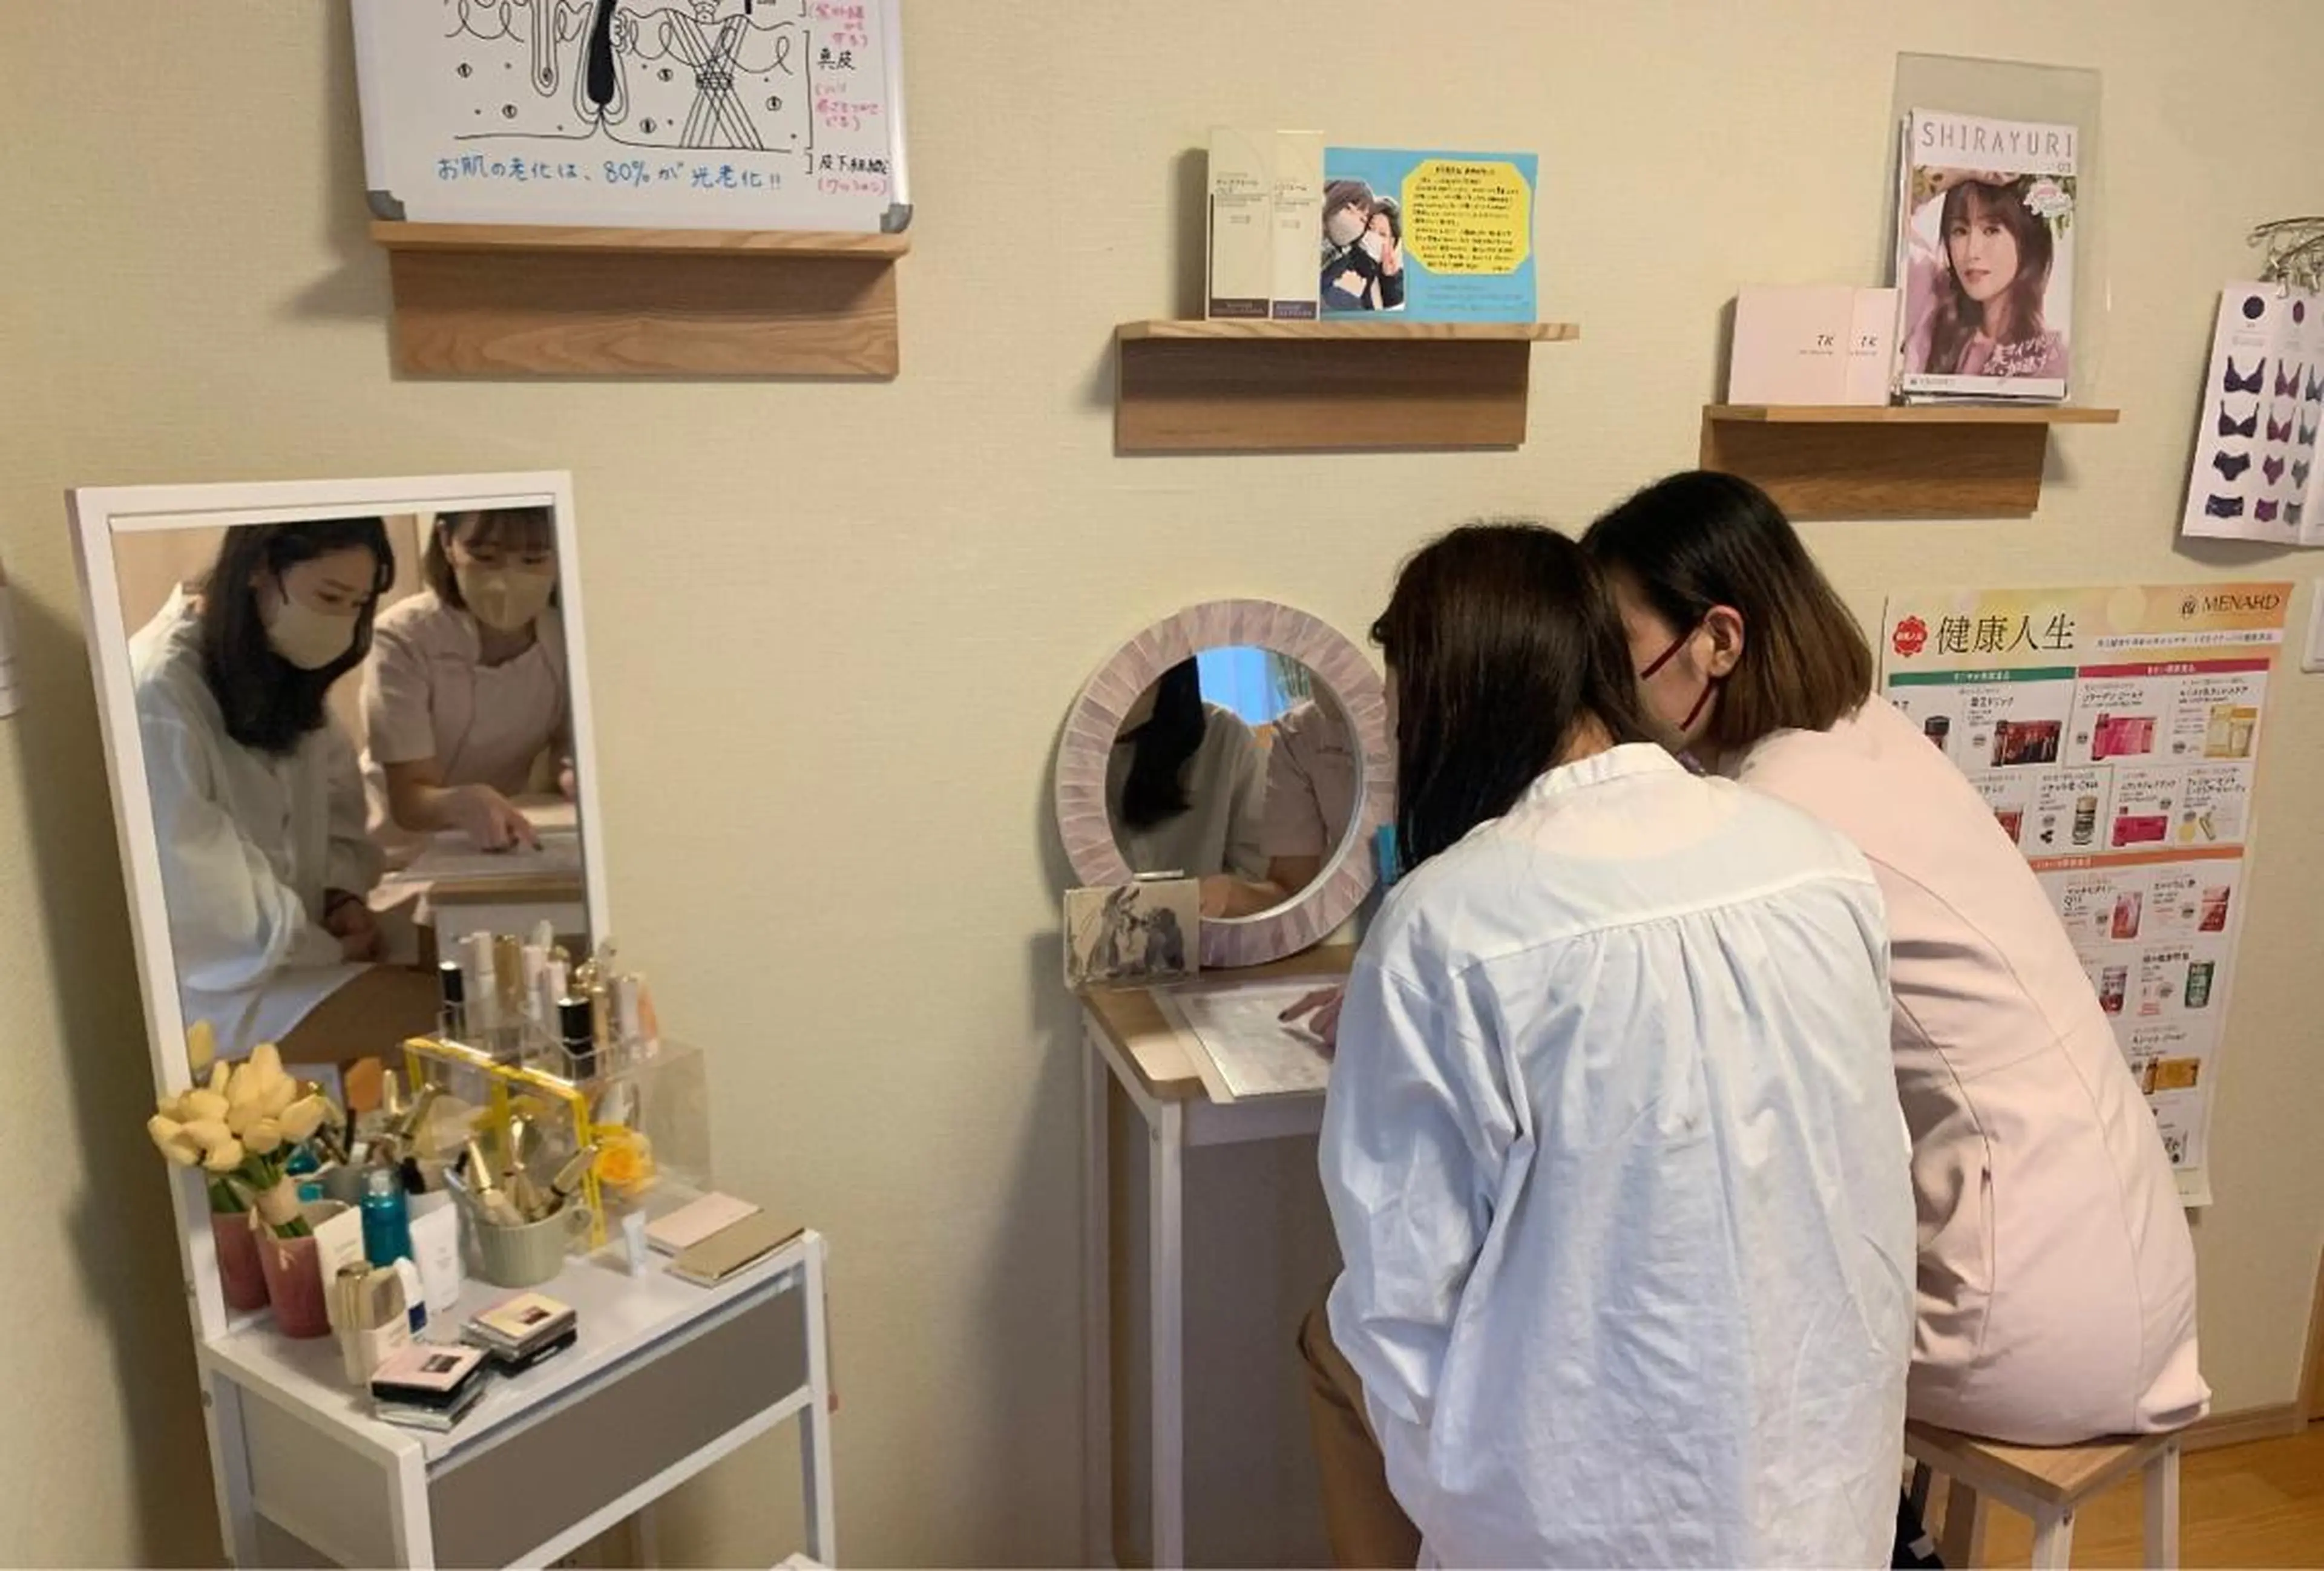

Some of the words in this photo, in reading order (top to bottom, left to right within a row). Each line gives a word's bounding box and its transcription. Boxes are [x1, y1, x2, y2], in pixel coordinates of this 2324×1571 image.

[817, 47, 856, 70] 真皮
[1921, 121, 2072, 159] SHIRAYURI
[2203, 593, 2280, 612] MENARD
[1935, 613, 2075, 655] 健康人生
